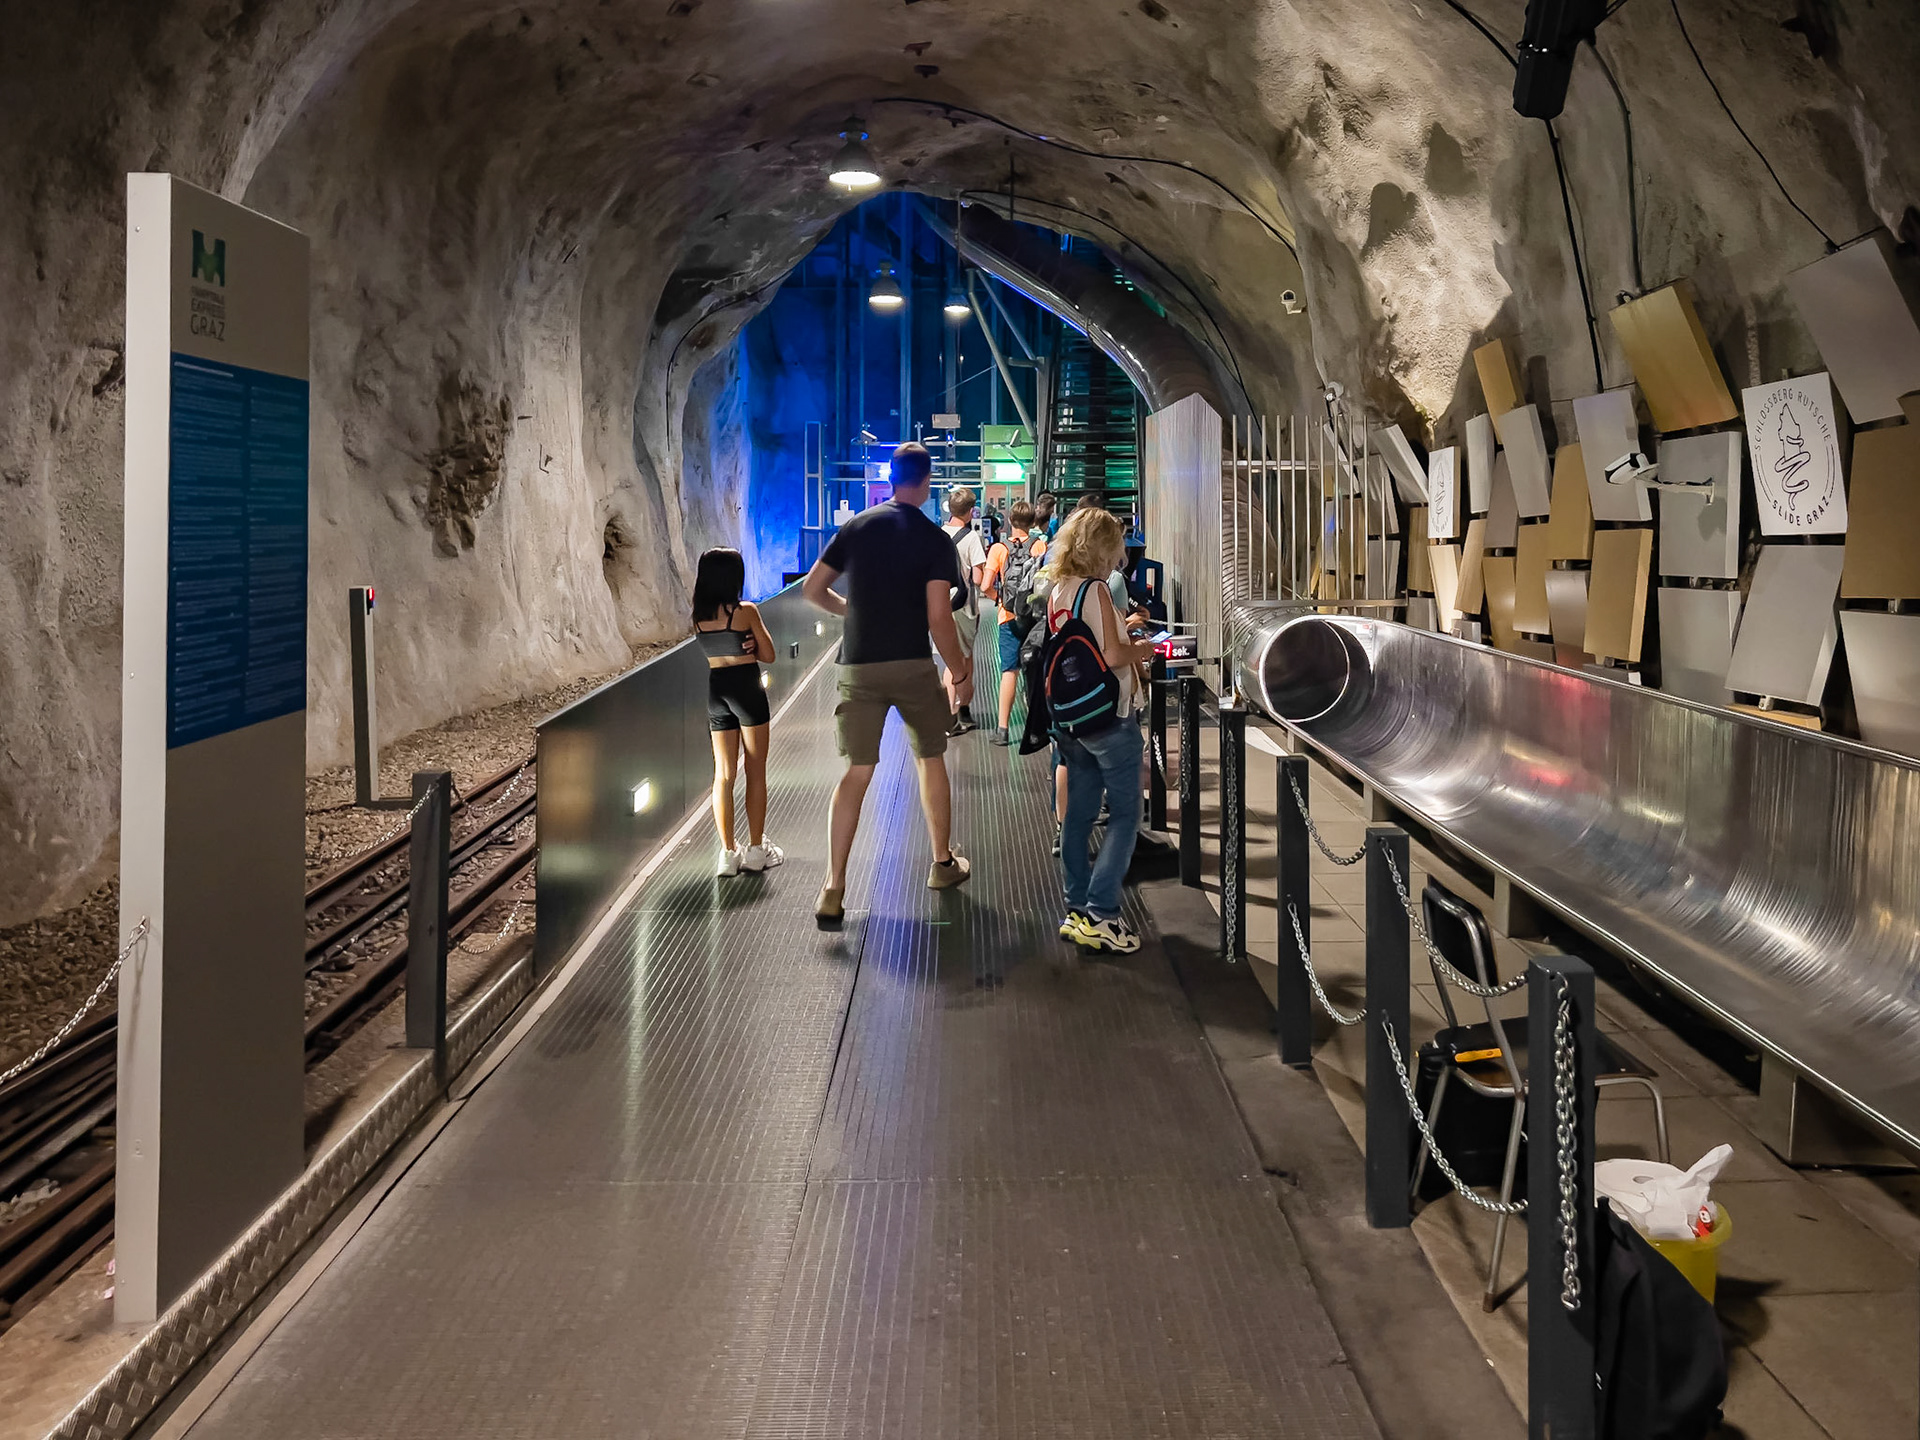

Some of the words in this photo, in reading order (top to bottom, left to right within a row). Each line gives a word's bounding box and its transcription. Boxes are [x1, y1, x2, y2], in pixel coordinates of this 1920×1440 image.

[190, 313, 225, 342] GRAZ
[1753, 387, 1794, 451] SCHLOSSBERG
[1797, 391, 1832, 443] RUTSCHE
[1772, 499, 1801, 527] SLIDE
[1806, 496, 1830, 525] GRAZ
